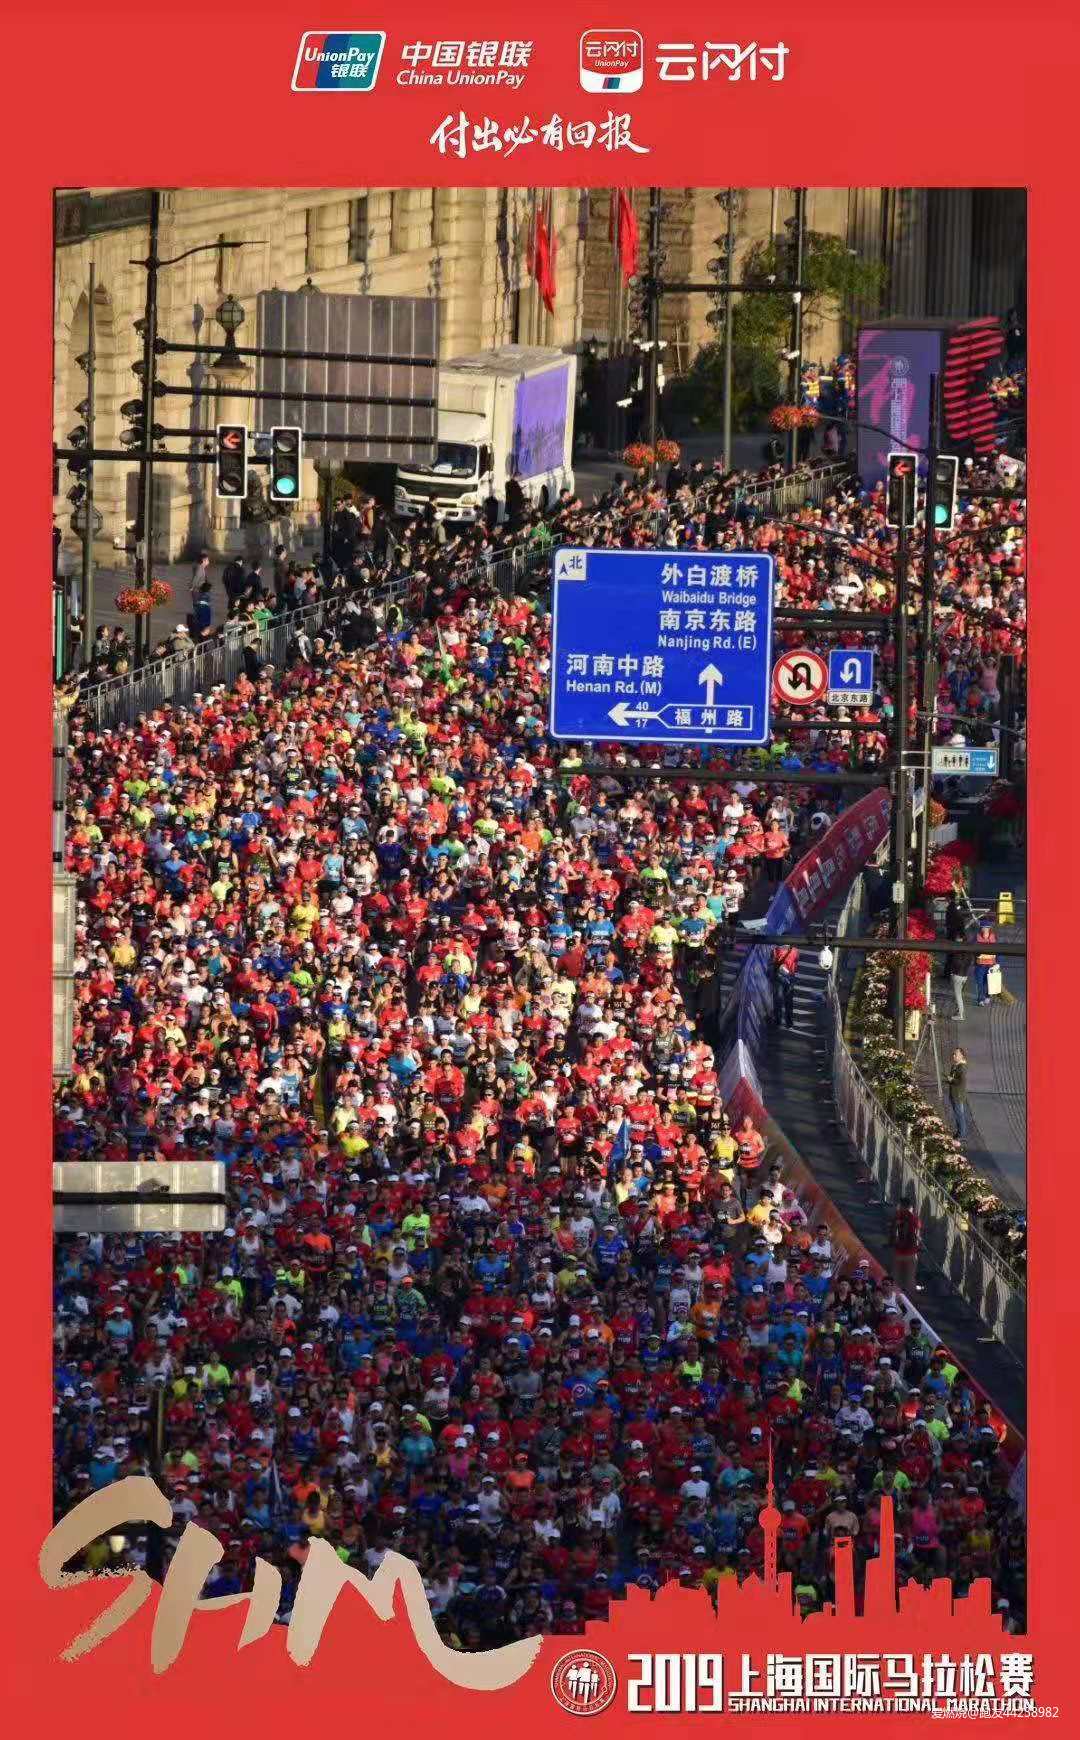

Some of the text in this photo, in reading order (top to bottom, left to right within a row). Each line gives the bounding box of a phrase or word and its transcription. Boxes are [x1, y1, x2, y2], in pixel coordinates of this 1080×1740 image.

[569, 556, 583, 569] 北
[661, 563, 759, 587] 外白渡桥
[662, 591, 757, 607] Waibaidu Bridge
[659, 608, 757, 632] 南京东路
[658, 635, 757, 650] Nanjing Rd. (E)
[566, 654, 665, 677] 河南中路
[566, 680, 662, 696] Henan Rd. (M)
[636, 702, 649, 711] 40
[636, 719, 648, 728] 17
[674, 708, 744, 727] 福州路
